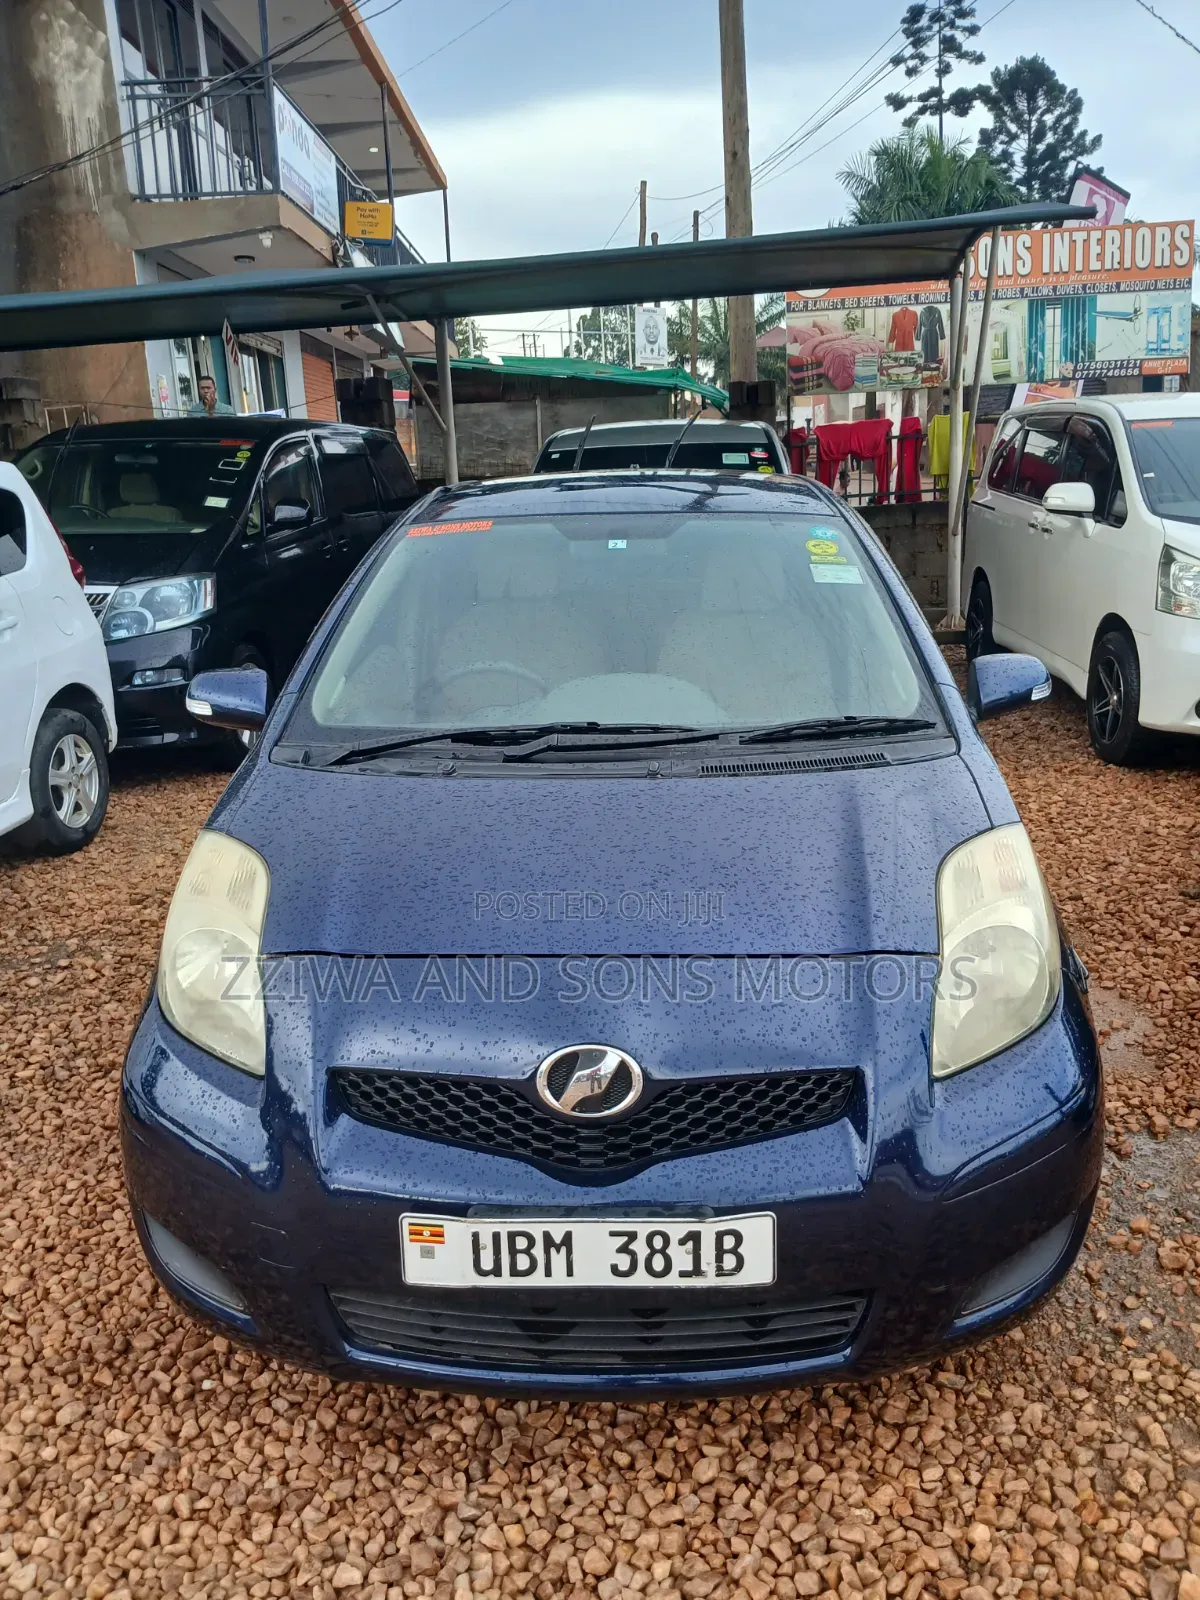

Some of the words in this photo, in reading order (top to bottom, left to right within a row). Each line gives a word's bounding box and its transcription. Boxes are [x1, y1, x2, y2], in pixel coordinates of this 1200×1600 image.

[1042, 224, 1191, 274] INTERIORS
[997, 277, 1014, 286] and
[1017, 275, 1047, 285] luxury
[1049, 275, 1057, 283] is
[1068, 272, 1110, 284] pleasure.
[808, 299, 843, 311] BLANKETS,
[844, 297, 858, 308] BED
[860, 296, 887, 308] SHEETS,
[888, 294, 917, 305] TOWELS,
[917, 292, 946, 304] IRONING
[997, 287, 1022, 299] ROBES,
[1023, 285, 1055, 297] PILLOWS,
[1056, 284, 1085, 295] DUVETS,
[1086, 282, 1118, 293] CLOSETS,
[1119, 280, 1155, 291] MOSQUITO
[1156, 279, 1174, 289] NETS
[1175, 278, 1191, 288] ETC.
[1076, 359, 1141, 370] 0756031121
[1166, 359, 1188, 367] PLAZA
[1075, 368, 1140, 379] 0777746656
[470, 1229, 575, 1278] UBM
[608, 1228, 746, 1278] 381B
